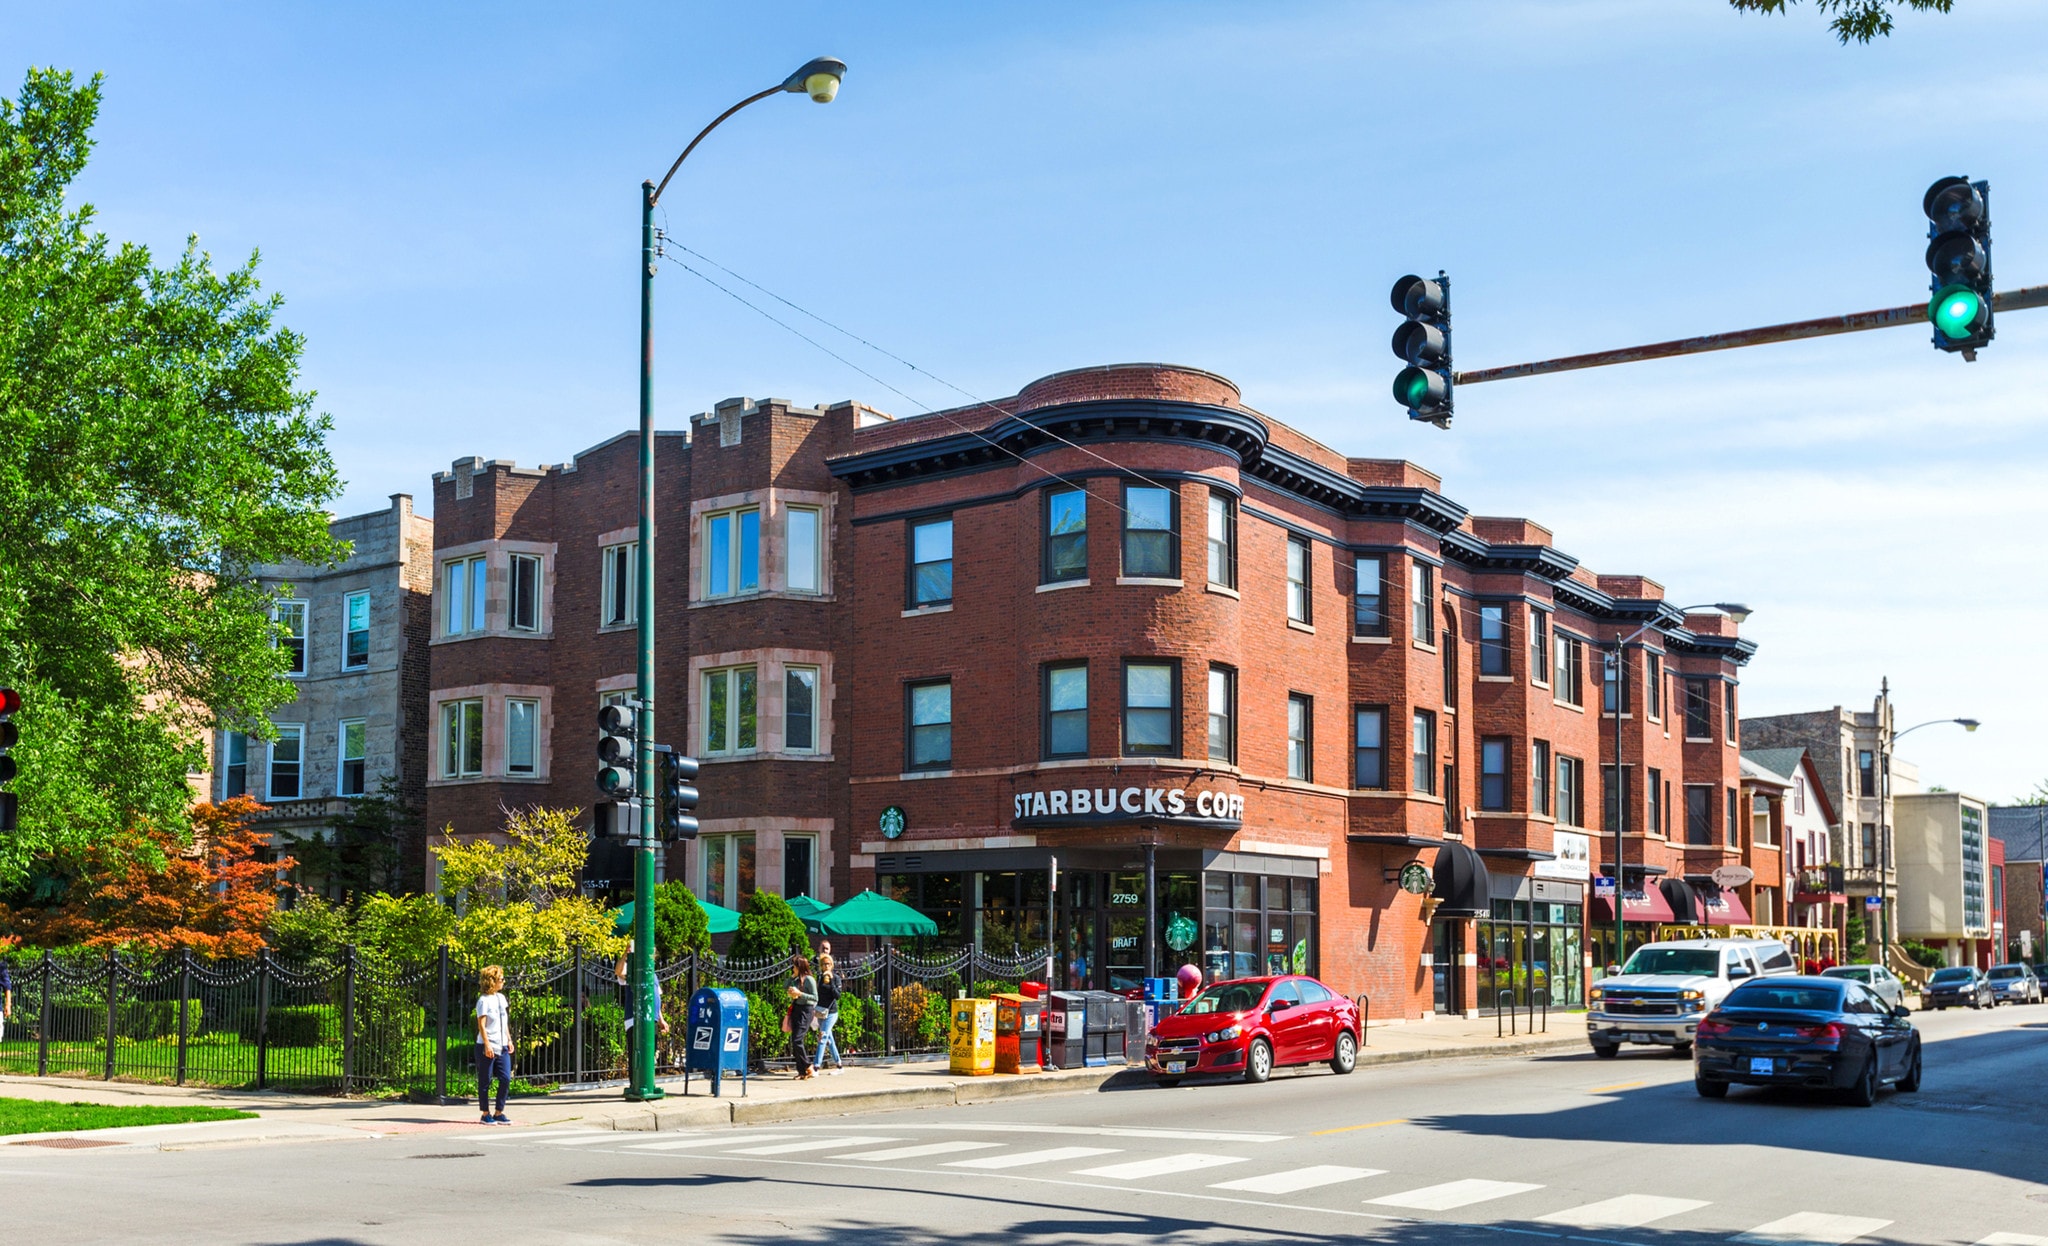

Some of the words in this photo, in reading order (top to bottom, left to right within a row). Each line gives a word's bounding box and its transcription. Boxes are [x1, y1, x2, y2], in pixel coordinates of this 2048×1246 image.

[1014, 787, 1186, 819] STARBUCKS
[1113, 893, 1138, 904] 2759
[1113, 936, 1138, 949] DRAFT
